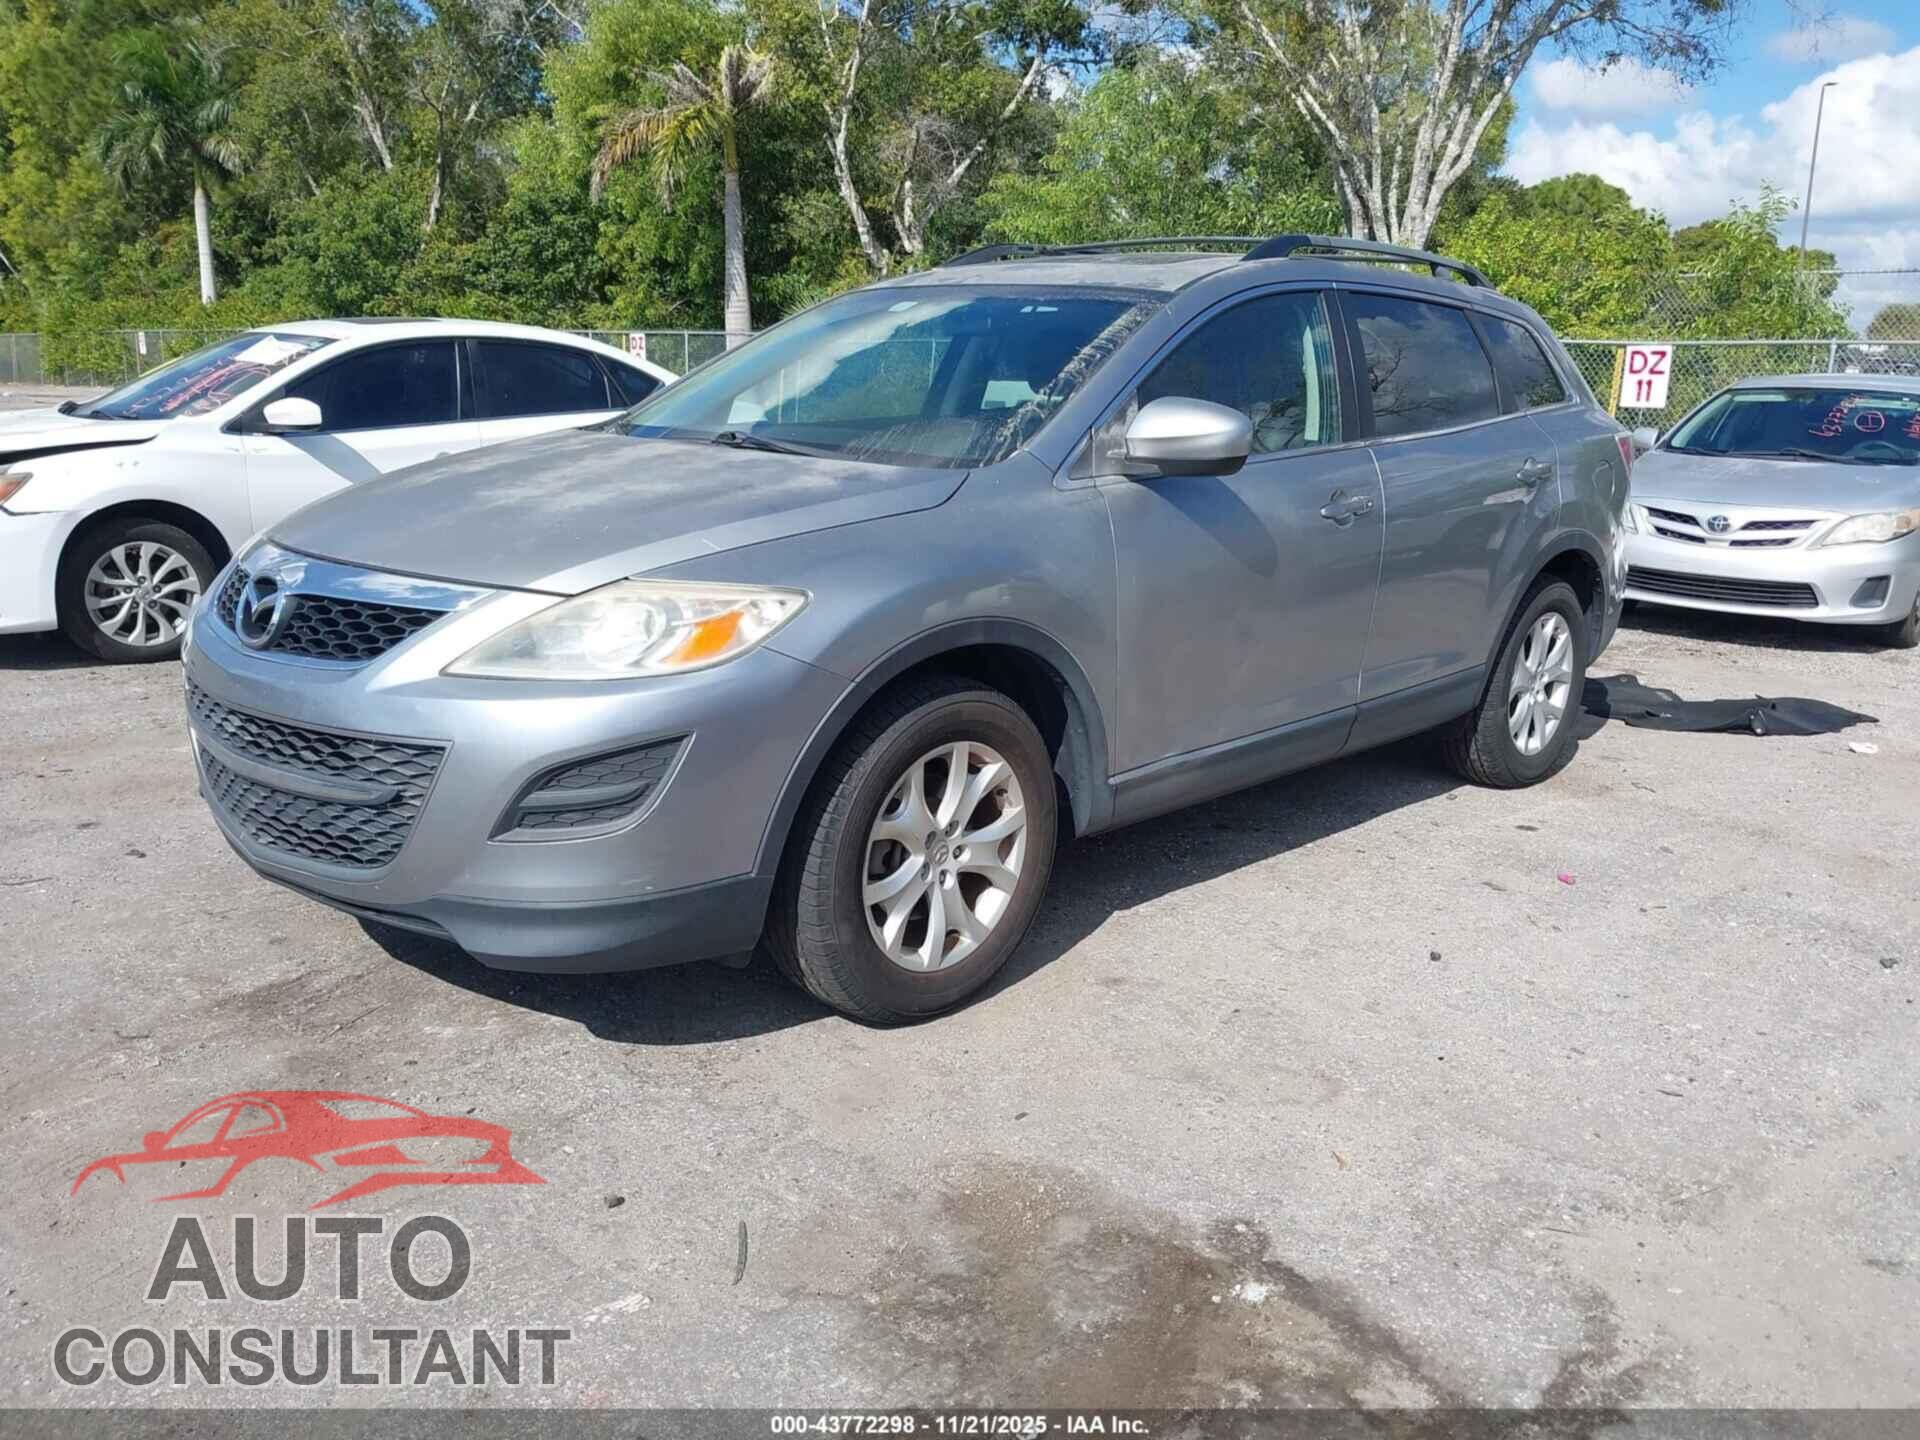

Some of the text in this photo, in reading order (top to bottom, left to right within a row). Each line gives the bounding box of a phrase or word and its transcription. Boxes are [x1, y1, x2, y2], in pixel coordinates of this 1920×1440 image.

[631, 336, 644, 350] DZ
[1629, 351, 1667, 375] DZ
[1636, 379, 1653, 402] 11
